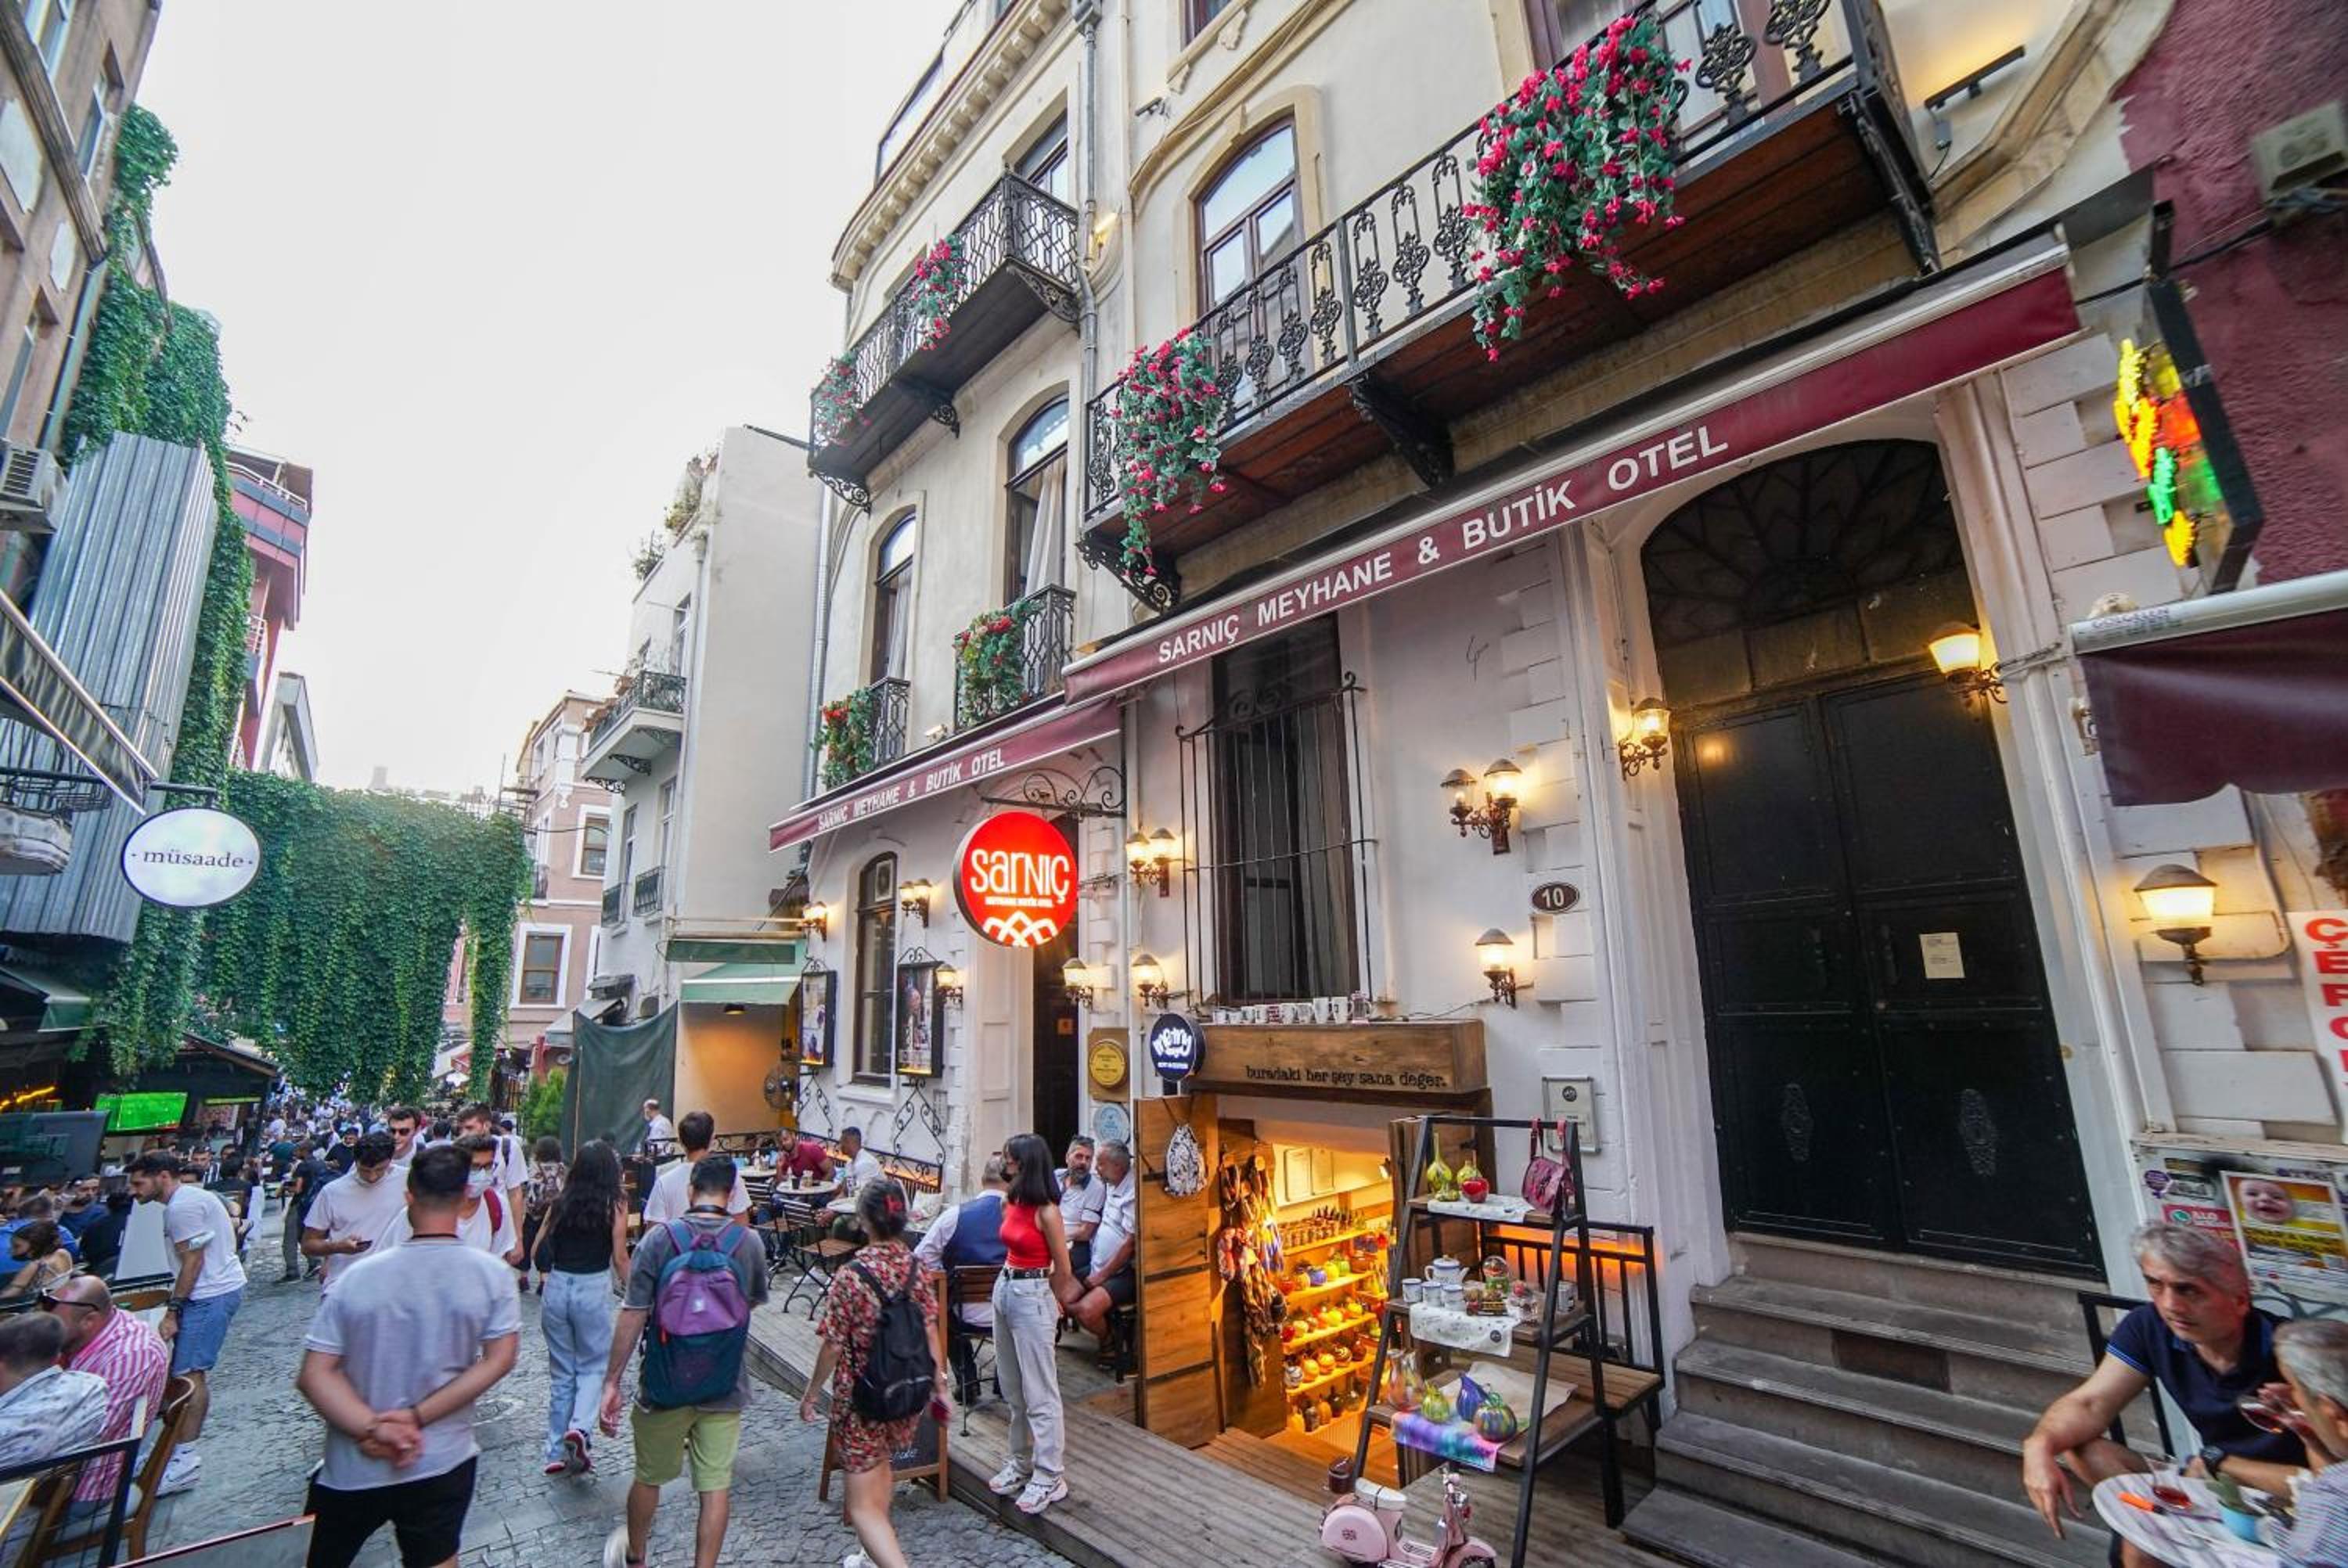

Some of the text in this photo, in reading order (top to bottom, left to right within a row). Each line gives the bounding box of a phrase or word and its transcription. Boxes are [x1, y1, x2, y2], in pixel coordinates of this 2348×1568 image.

[1158, 425, 1728, 664] SARNIÇ MEYHANE & BUTİK OTEL
[853, 786, 901, 818] MEYHANE
[907, 781, 917, 798] &
[926, 761, 963, 793] BUTİK
[971, 748, 1005, 774] OTEL
[143, 848, 243, 868] müsaade
[1542, 887, 1565, 908] 10
[1245, 1065, 1302, 1081] buradaki
[1305, 1067, 1328, 1082] her
[1359, 1073, 1394, 1085] sana
